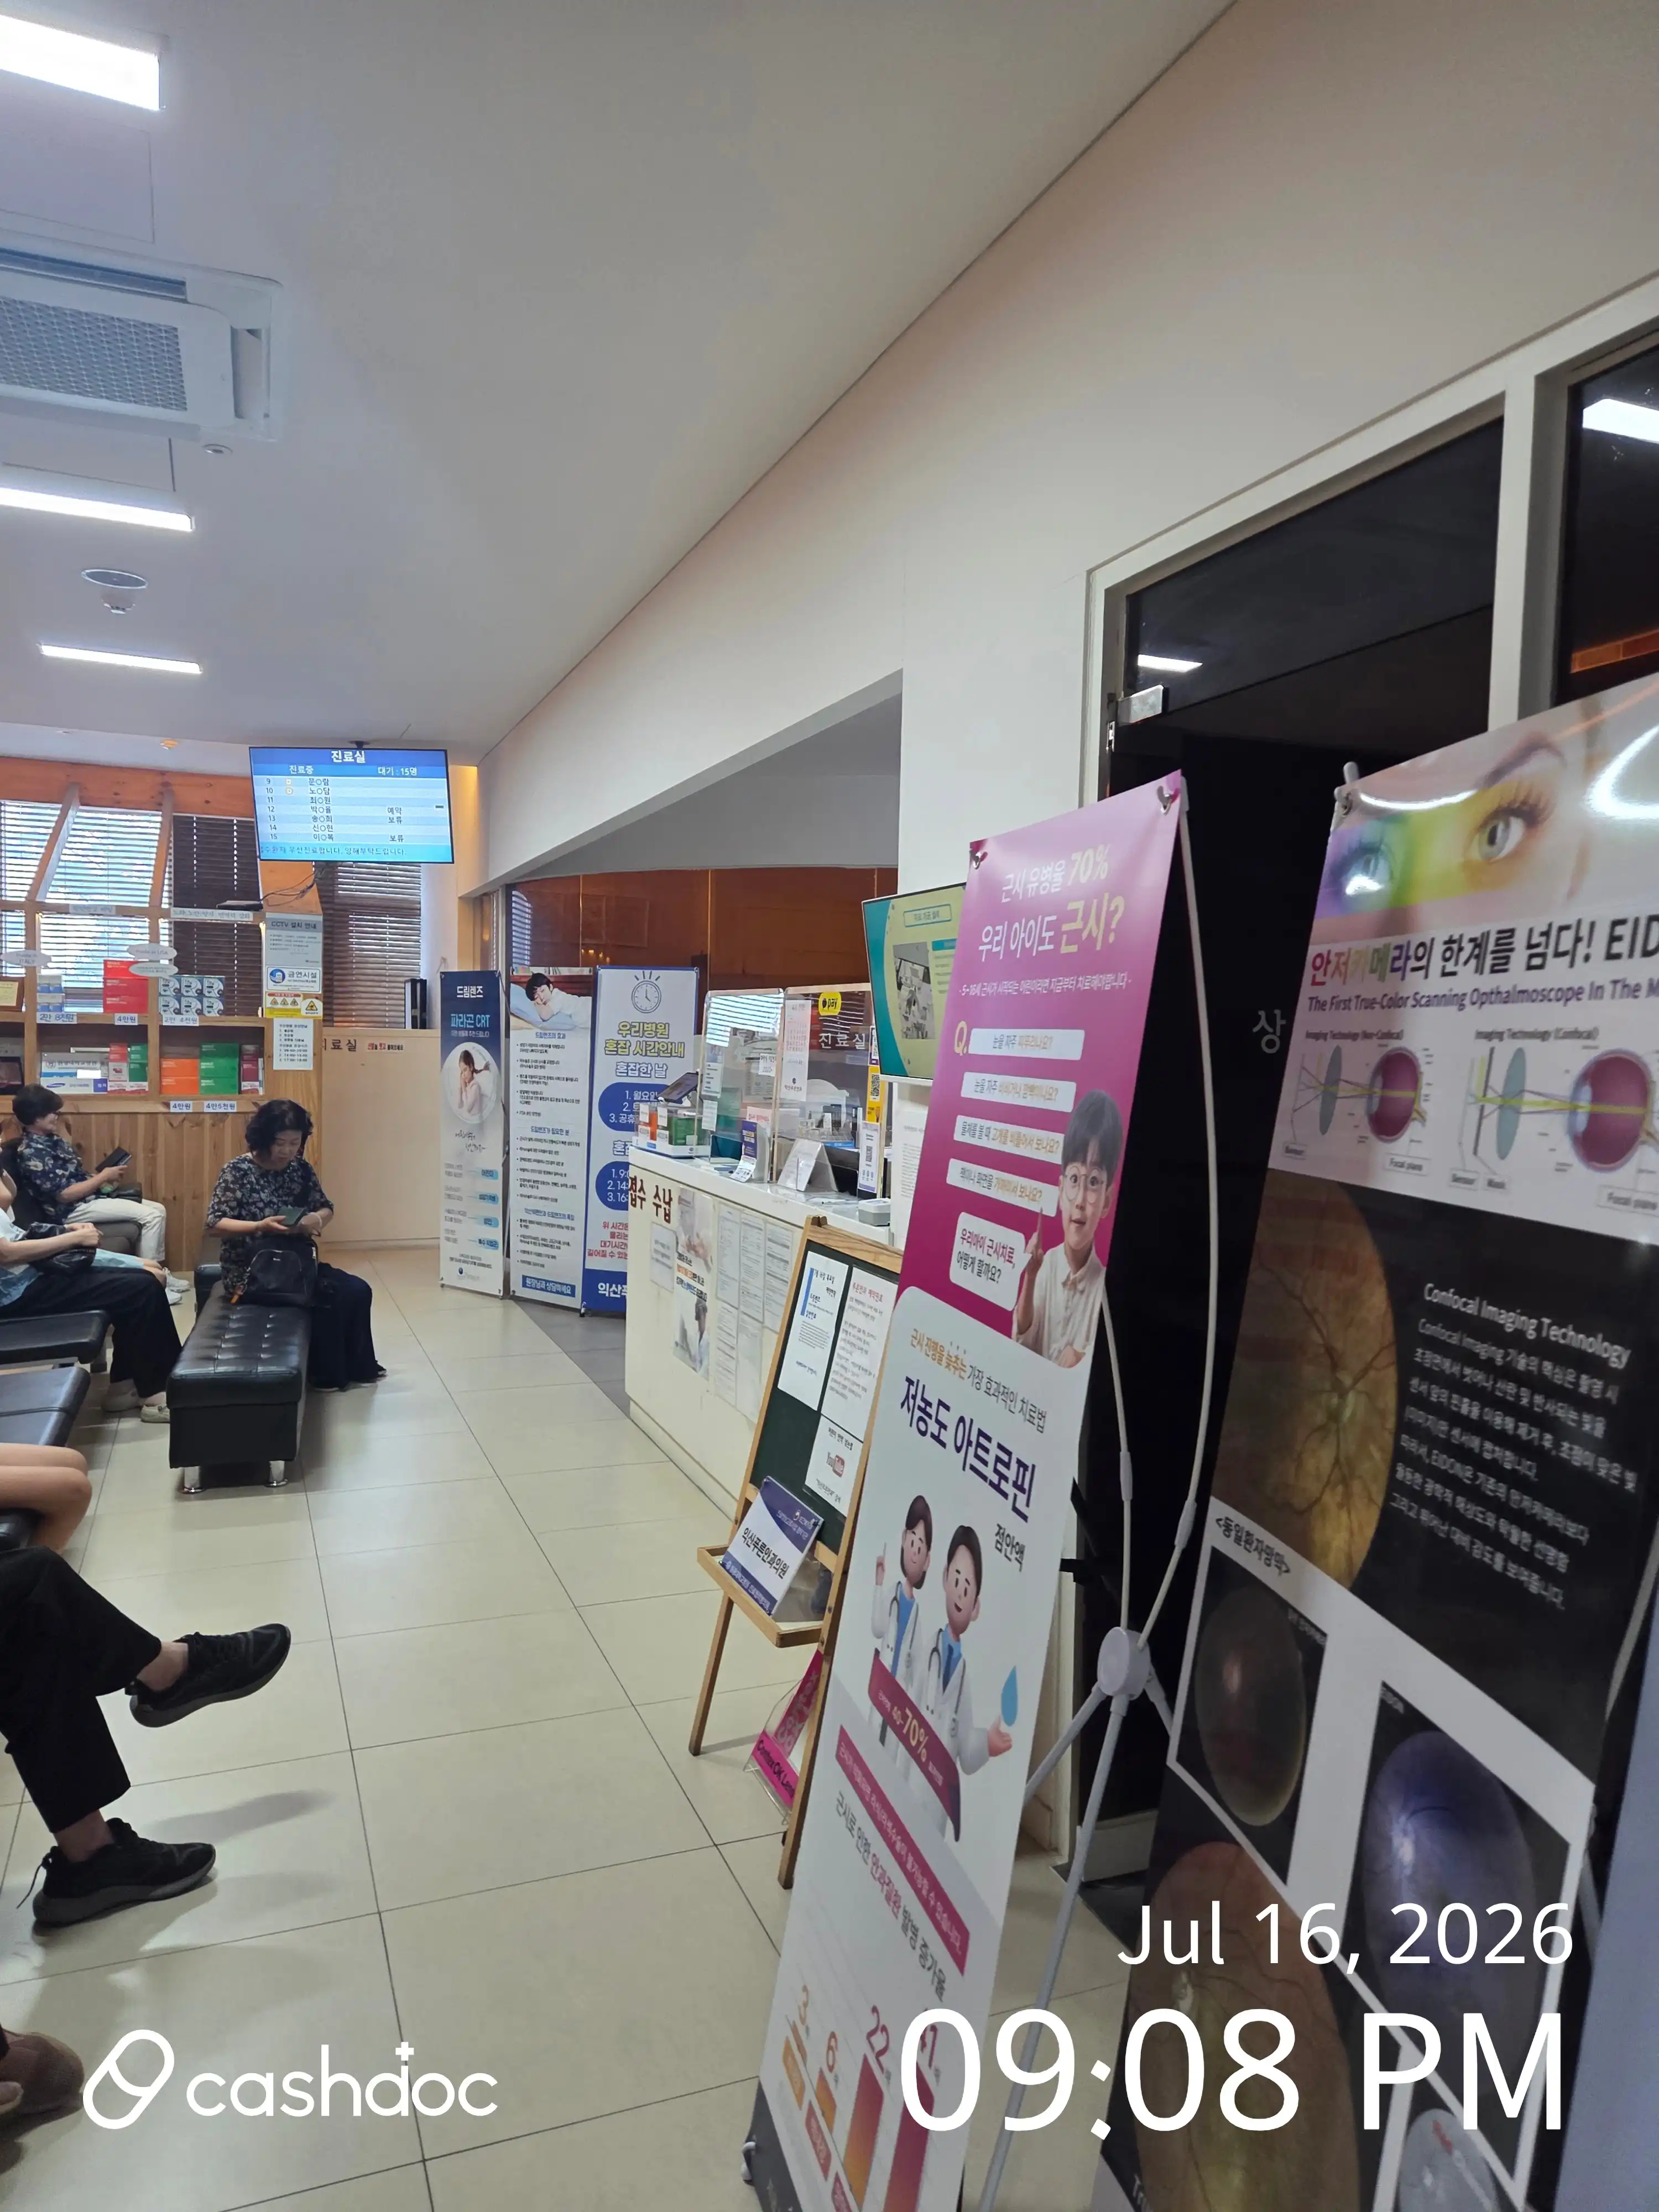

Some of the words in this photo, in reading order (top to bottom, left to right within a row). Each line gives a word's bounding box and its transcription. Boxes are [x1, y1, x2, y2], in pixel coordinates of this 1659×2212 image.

[331, 750, 366, 764] 진료실
[289, 765, 314, 774] 진료중
[378, 767, 394, 775] 대기
[400, 767, 418, 776] 15명
[388, 807, 402, 815] 예약
[1001, 868, 1025, 903] 근시
[1067, 844, 1111, 886] 70%
[979, 920, 1008, 962] 우리
[1010, 915, 1057, 958] 아이도
[1060, 892, 1125, 954] 근시?
[1311, 938, 1435, 987] 안저카메라의
[1441, 927, 1516, 977] 한계를
[1526, 917, 1596, 972] 넘다!
[457, 986, 483, 998] 드림렌즈
[1308, 996, 1327, 1013] The
[1329, 995, 1352, 1013] First
[1354, 992, 1409, 1011] True-Color
[1411, 990, 1467, 1011] Scanning
[1588, 982, 1604, 1000] In
[1610, 978, 1641, 999] The
[827, 998, 838, 1009] pay
[39, 1014, 51, 1022] 2만
[117, 1015, 136, 1024] 4만원
[451, 1014, 474, 1028] 파라곤
[476, 1015, 490, 1028] CRT
[618, 1021, 669, 1039] 우리병원
[954, 1020, 968, 1056] Q.
[1253, 1009, 1286, 1055] 상
[605, 1040, 630, 1055] 혼잡
[633, 1041, 685, 1058] 시간안내
[818, 1033, 865, 1050] 진료실
[615, 1061, 653, 1077] 혼잡한
[655, 1063, 668, 1078] 날
[625, 1091, 632, 1099] 1.
[633, 1091, 658, 1101] 월요일
[609, 1114, 617, 1123] 3.
[612, 1169, 617, 1178] 1.
[607, 1180, 615, 1190] 2.
[607, 1192, 615, 1201] 3.
[629, 1175, 646, 1210] 접수
[653, 1185, 672, 1224] 수납
[602, 1221, 609, 1229] 위
[609, 1250, 615, 1259] 수
[959, 1228, 986, 1255] 우리아이
[986, 1237, 1016, 1269] 근시치료,
[956, 1250, 976, 1271] 어떻게
[977, 1259, 1002, 1284] 할까요?
[526, 1277, 545, 1289] 원장님과
[1424, 1283, 1479, 1316] Confocal
[1481, 1299, 1537, 1340] Imaging
[1541, 1318, 1631, 1369] Technology
[1418, 1318, 1461, 1347] Confocal
[1462, 1335, 1504, 1366] Imaging
[910, 1328, 925, 1351] 근시
[925, 1337, 945, 1366] 진행을
[945, 1350, 967, 1380] 늦추는
[968, 1365, 984, 1391] 가장
[983, 1375, 1018, 1415] 효과적인
[1018, 1396, 1046, 1433] 치료법
[900, 1376, 951, 1449] 저농도
[954, 1415, 1036, 1524] 아트로핀
[742, 1526, 790, 1579] 익산푸른안과의원
[995, 1524, 1026, 1572] 점안액
[836, 1790, 857, 1838] 근시로
[857, 1828, 872, 1865] 인한
[870, 1853, 902, 1919] 안과질환
[902, 1905, 919, 1950] 발병
[919, 1937, 946, 2003] 증가율
[799, 1984, 809, 2026] 3
[867, 2005, 890, 2075] 22
